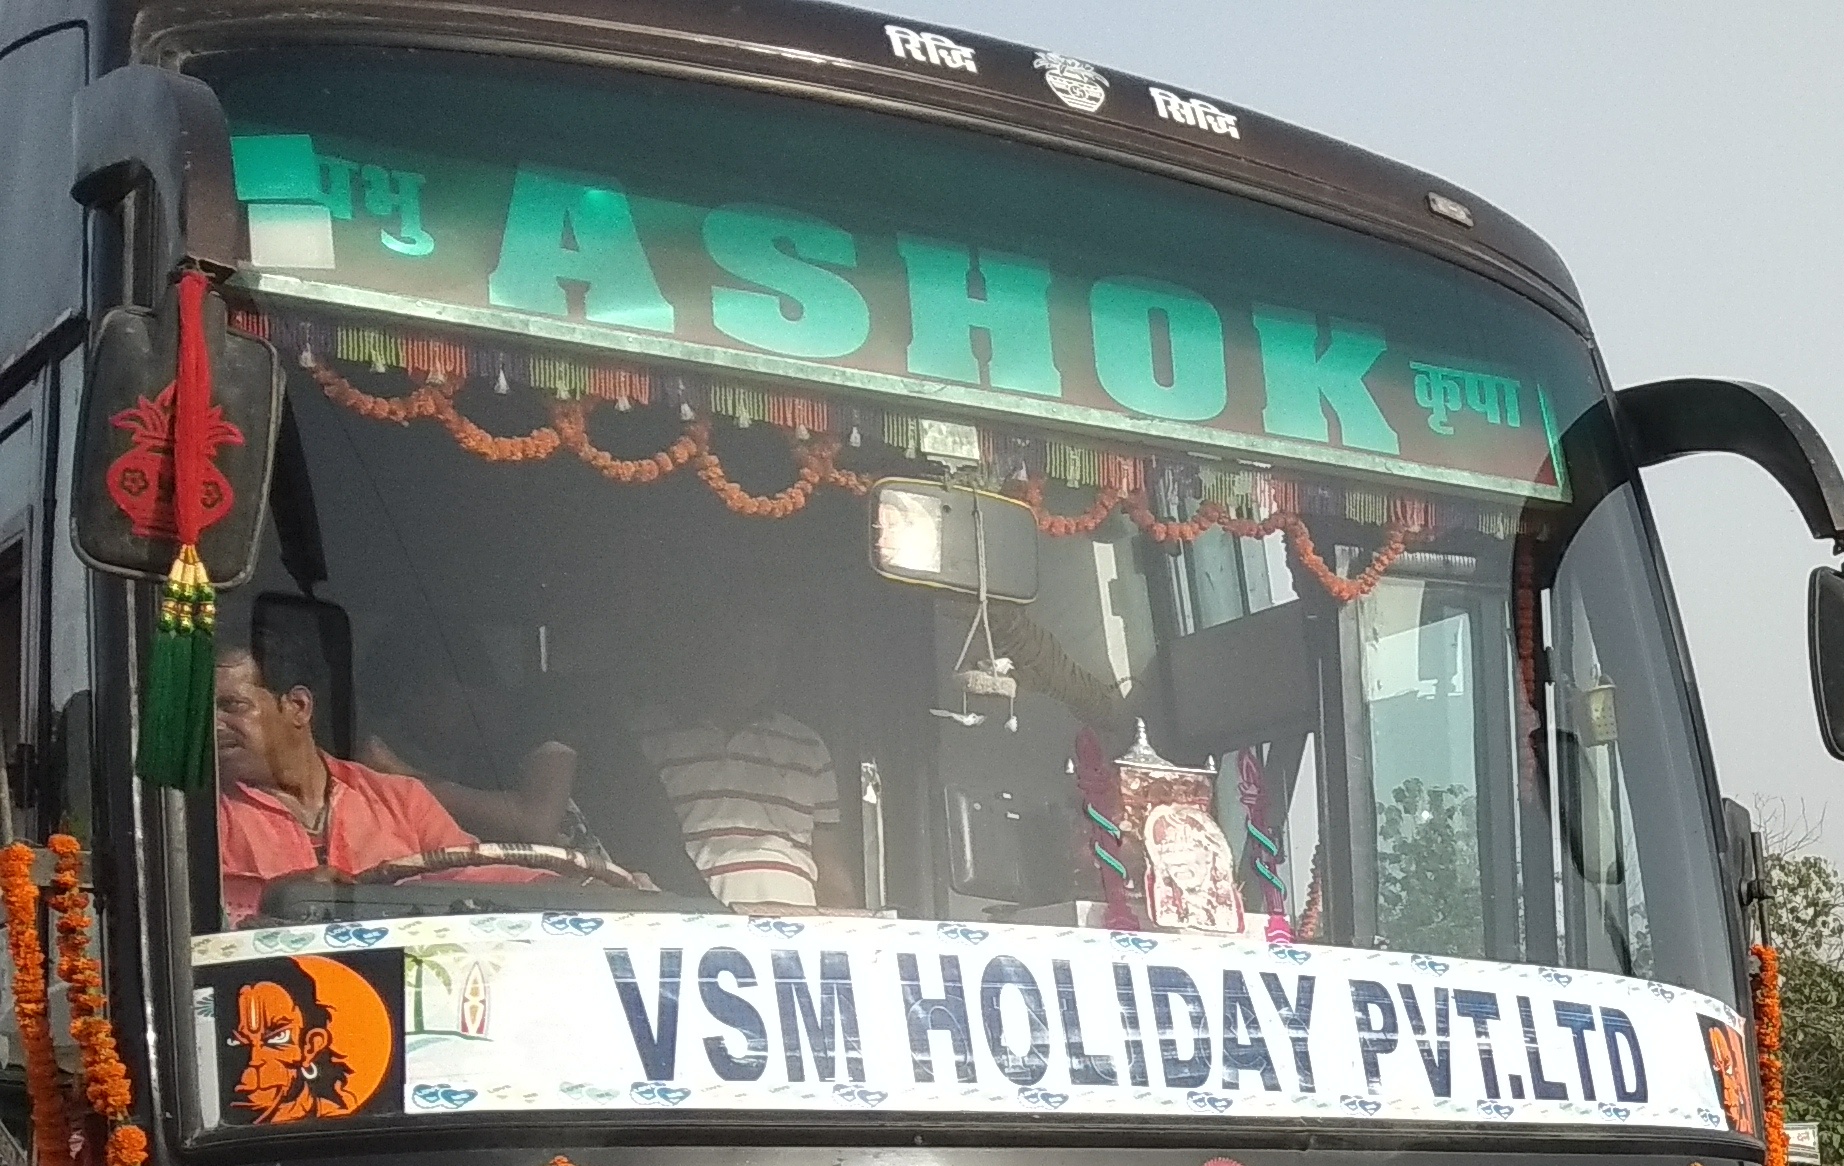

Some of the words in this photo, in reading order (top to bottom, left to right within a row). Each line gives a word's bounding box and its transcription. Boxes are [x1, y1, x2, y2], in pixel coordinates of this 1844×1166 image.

[487, 158, 1401, 457] ASHOK
[1408, 360, 1521, 436] कृपा
[603, 945, 866, 1084] VSM
[896, 950, 1317, 1095] HOLIDAY
